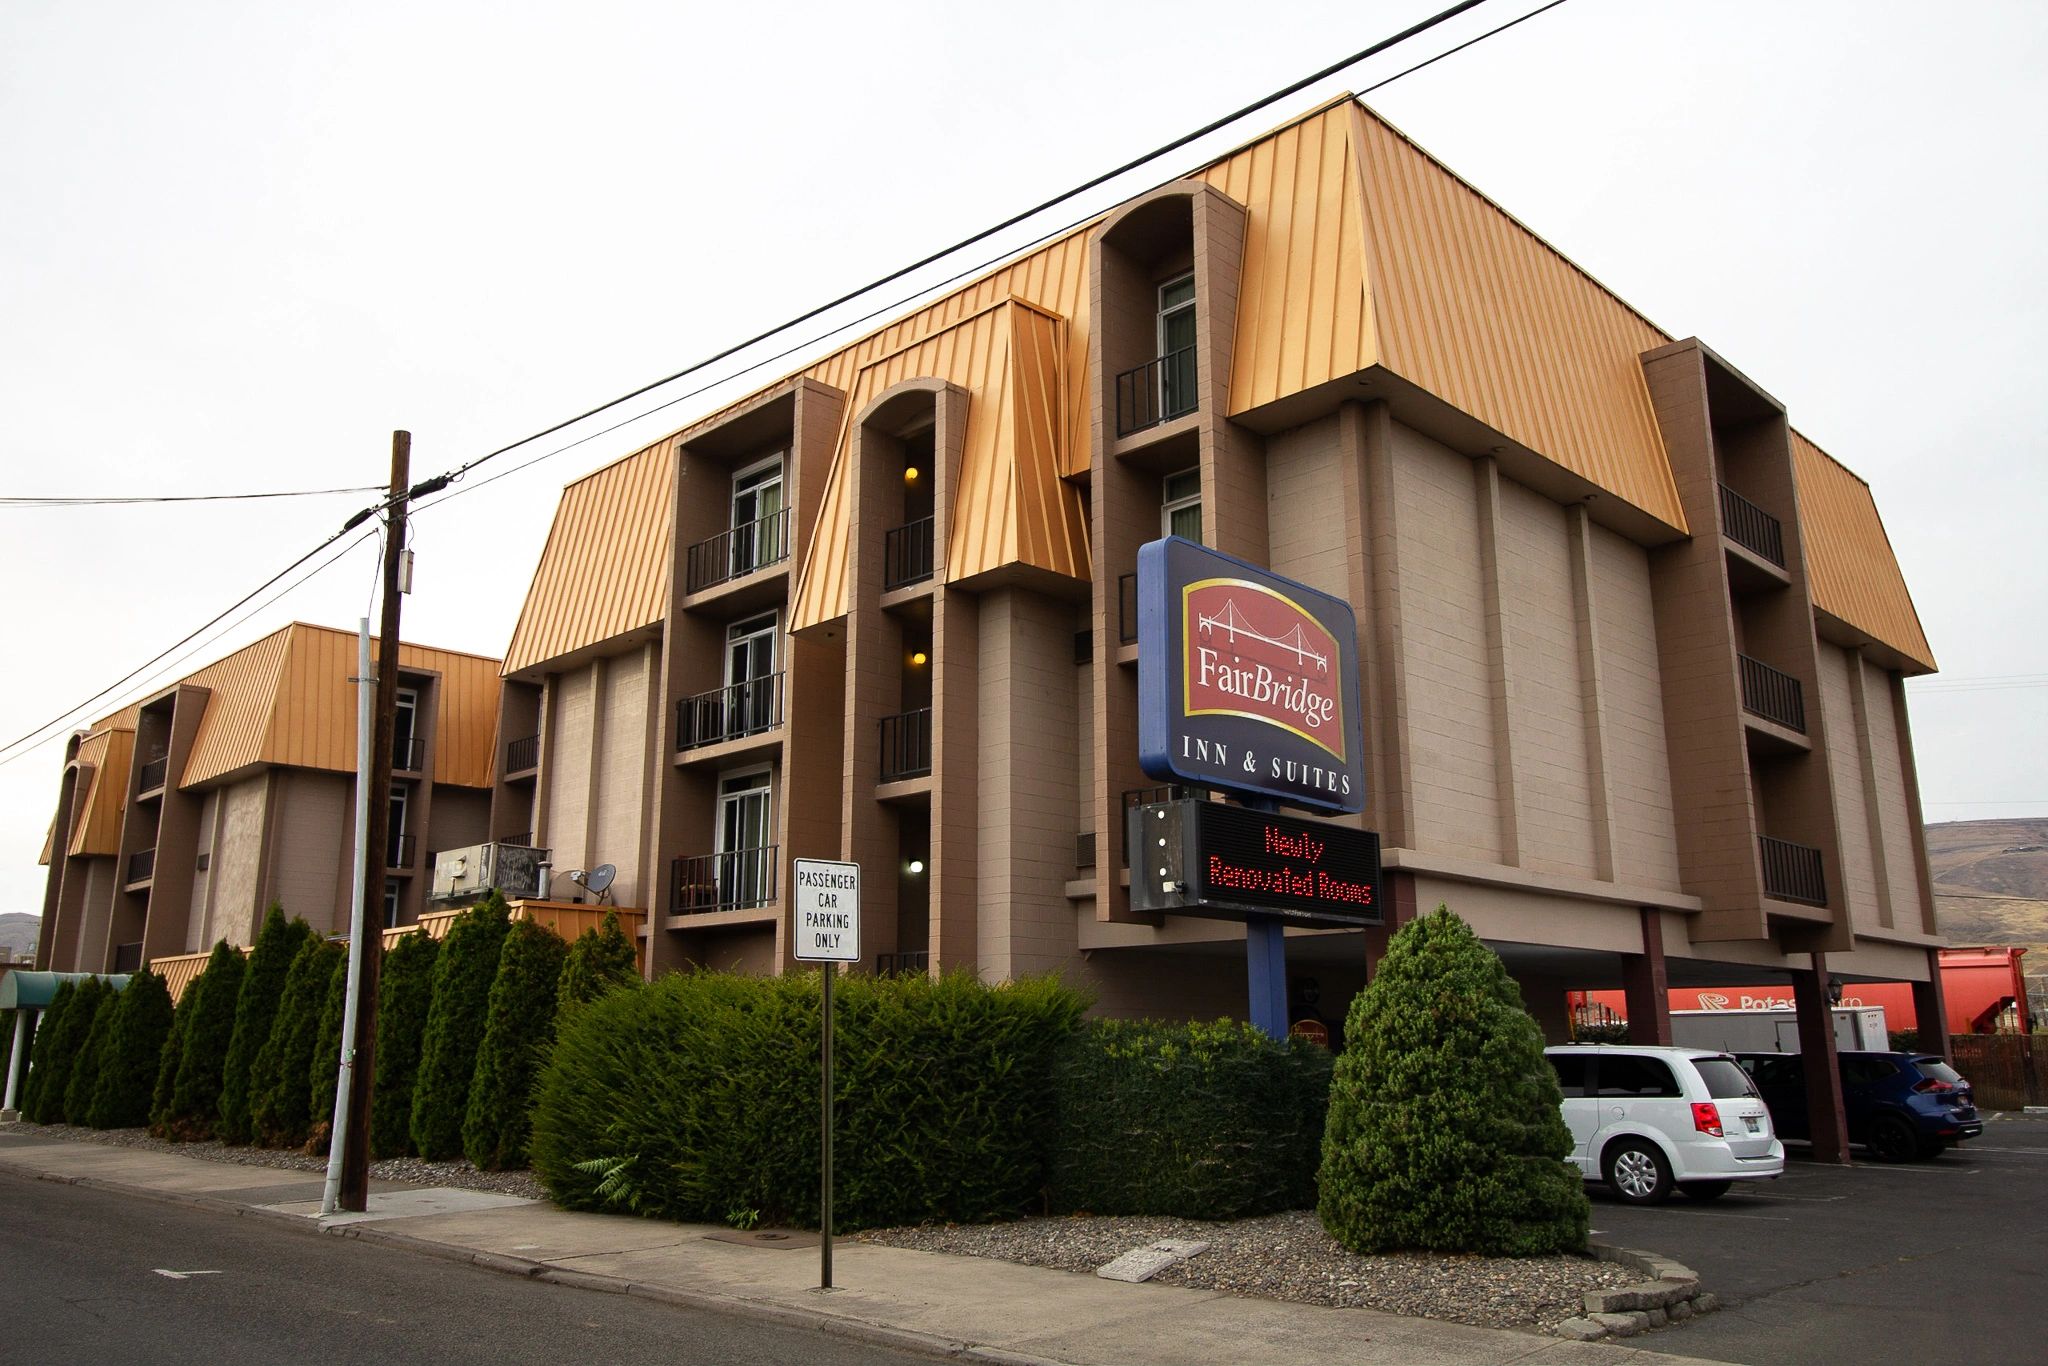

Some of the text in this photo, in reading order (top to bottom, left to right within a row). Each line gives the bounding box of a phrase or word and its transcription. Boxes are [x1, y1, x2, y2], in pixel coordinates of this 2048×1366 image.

[1197, 646, 1334, 728] FairBridge
[1182, 735, 1351, 795] INN & SUITES
[1265, 825, 1325, 864] Newly
[799, 871, 856, 890] PASSENGER
[1210, 855, 1372, 905] Renovated Rooms
[818, 892, 838, 909] CAR
[806, 912, 849, 929] PARKING
[815, 932, 841, 949] ONLY
